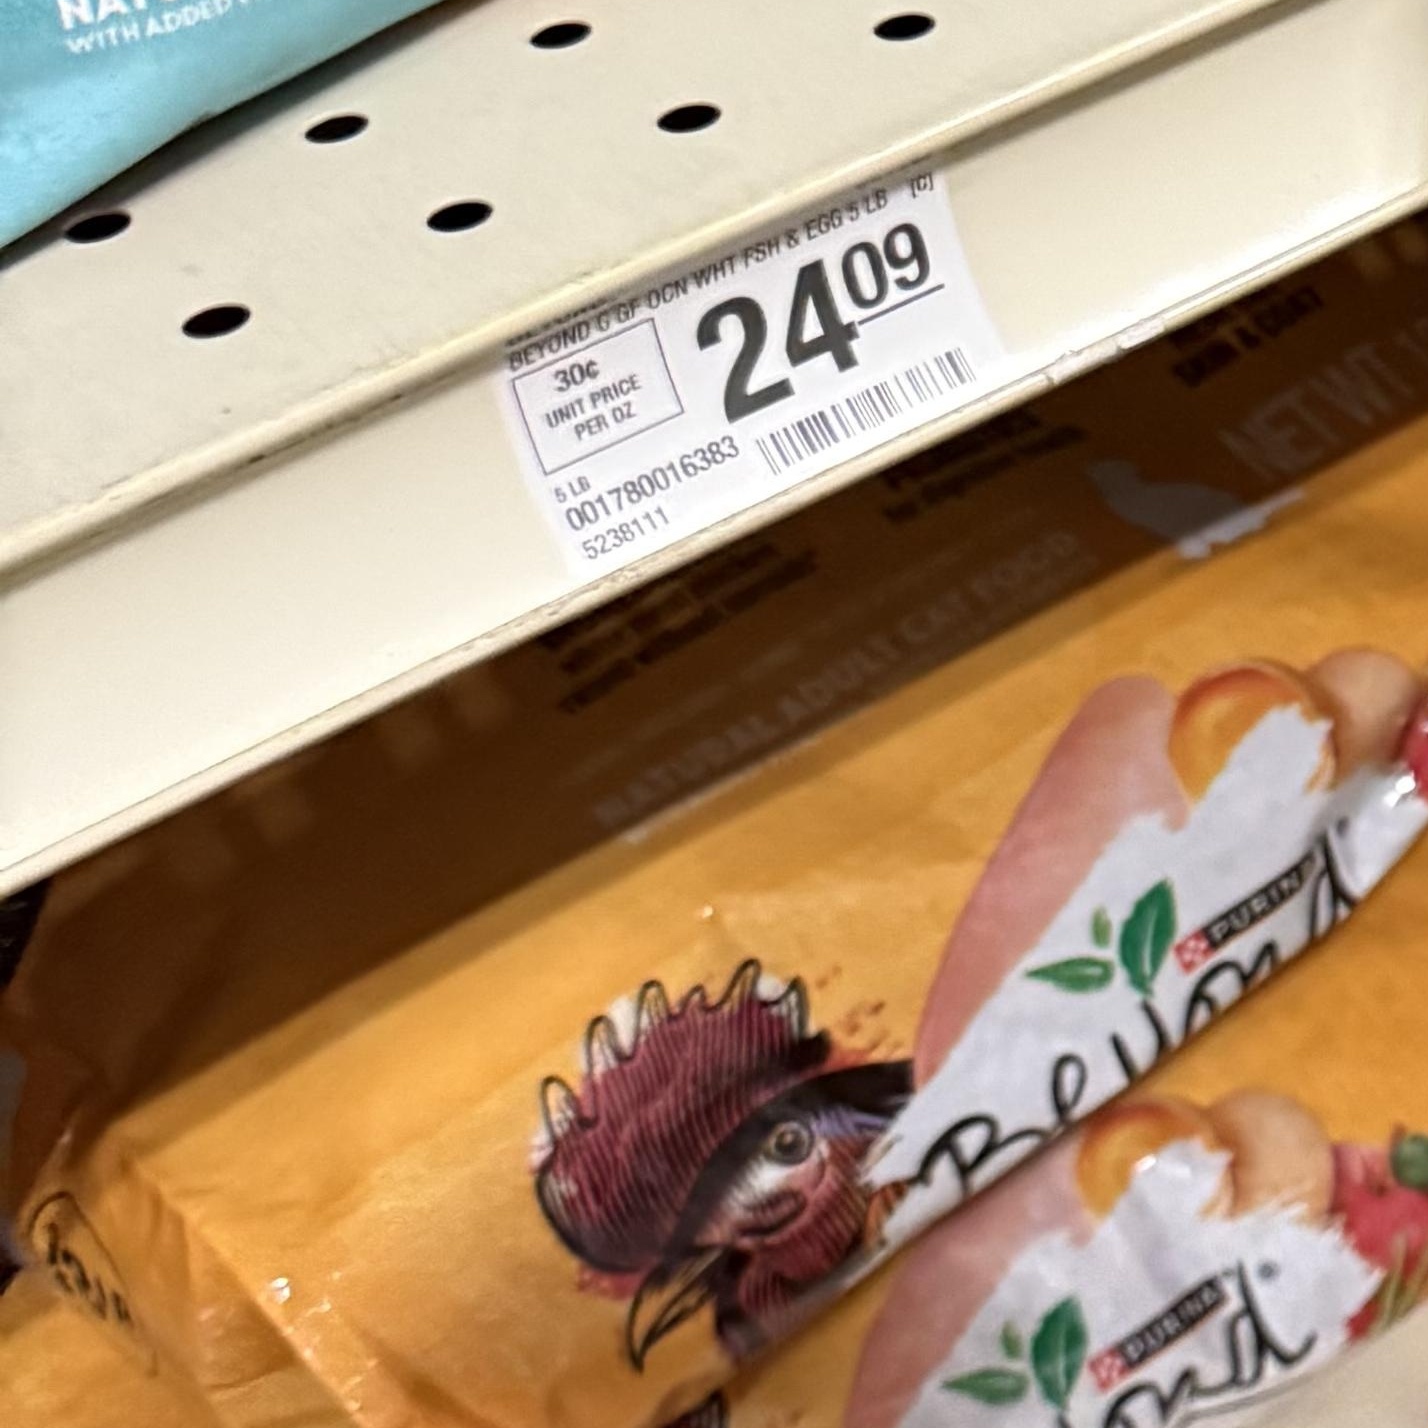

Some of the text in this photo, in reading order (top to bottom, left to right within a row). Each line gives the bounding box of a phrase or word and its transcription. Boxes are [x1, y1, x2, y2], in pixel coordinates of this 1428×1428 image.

[66, 14, 142, 56] WITH
[508, 319, 591, 372] BEYOND
[696, 256, 739, 289] WHT
[742, 239, 781, 271] FSH
[786, 229, 801, 249] &
[805, 211, 844, 241] EGG
[848, 203, 861, 223] 5
[864, 189, 889, 213] LB
[544, 372, 643, 429] UNIT PRICE
[552, 358, 601, 394] 30¢
[573, 401, 637, 442] PER OZ
[553, 475, 592, 504] 5 LB
[564, 434, 740, 533] 001780016383
[581, 506, 670, 561] 5238111
[1209, 853, 1315, 943] PURIN
